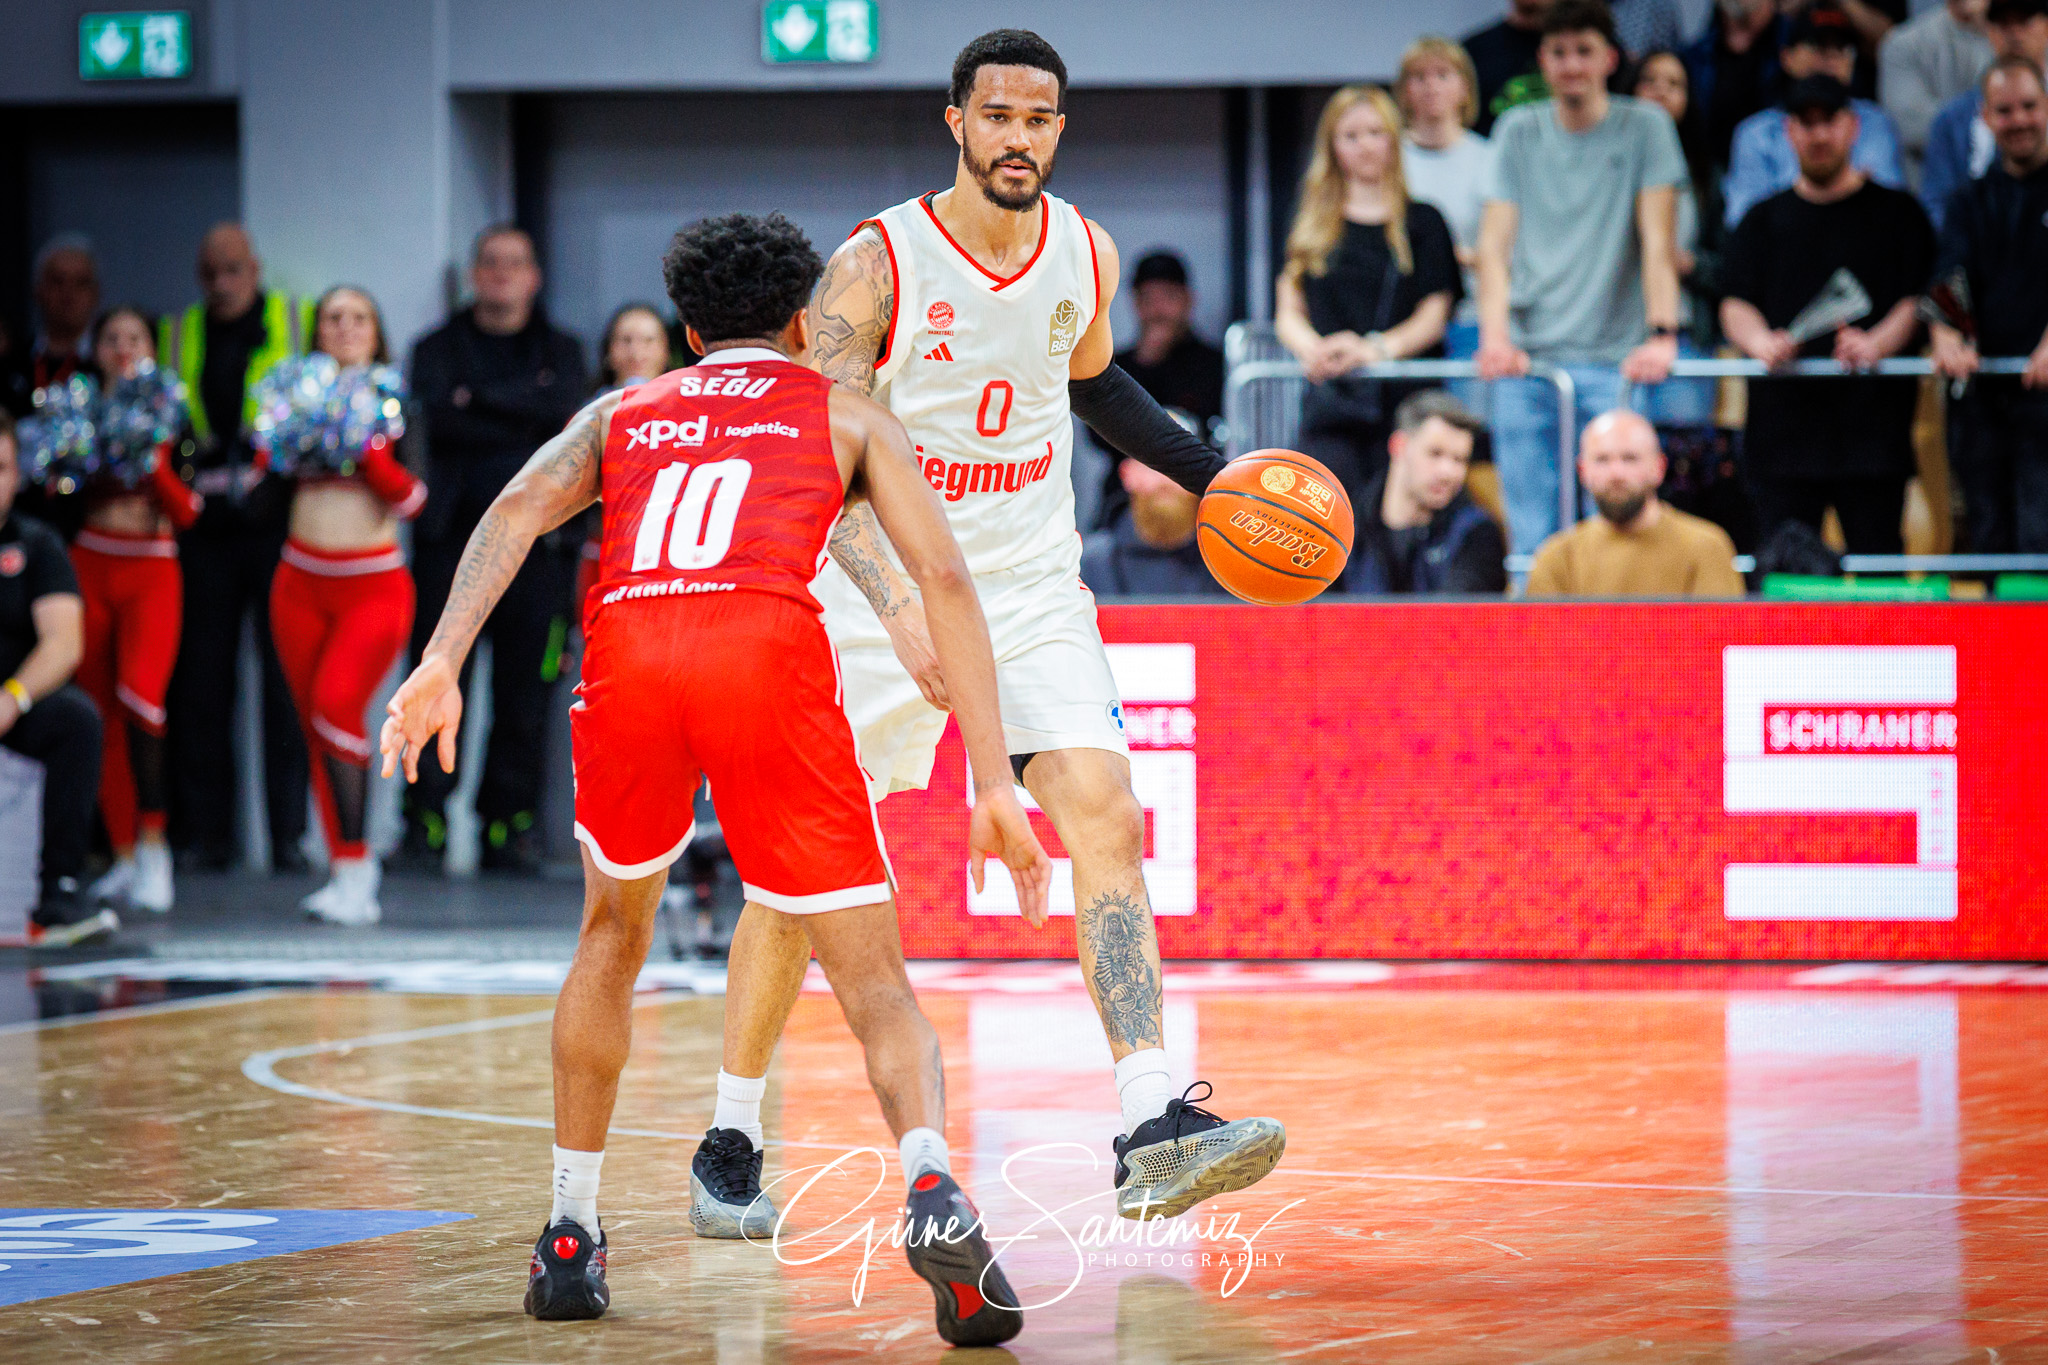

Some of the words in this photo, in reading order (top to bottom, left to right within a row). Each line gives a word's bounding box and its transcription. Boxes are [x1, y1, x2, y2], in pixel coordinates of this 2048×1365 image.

[1051, 339, 1070, 353] BBL
[680, 376, 778, 399] SEGU
[976, 380, 1013, 437] 0
[625, 415, 708, 451] xpd
[725, 421, 800, 438] logistics
[915, 441, 1052, 501] iegmund
[1303, 477, 1332, 502] BBL
[631, 458, 752, 572] 10
[1229, 509, 1329, 569] Baden
[1767, 710, 1957, 751] SCHRANER
